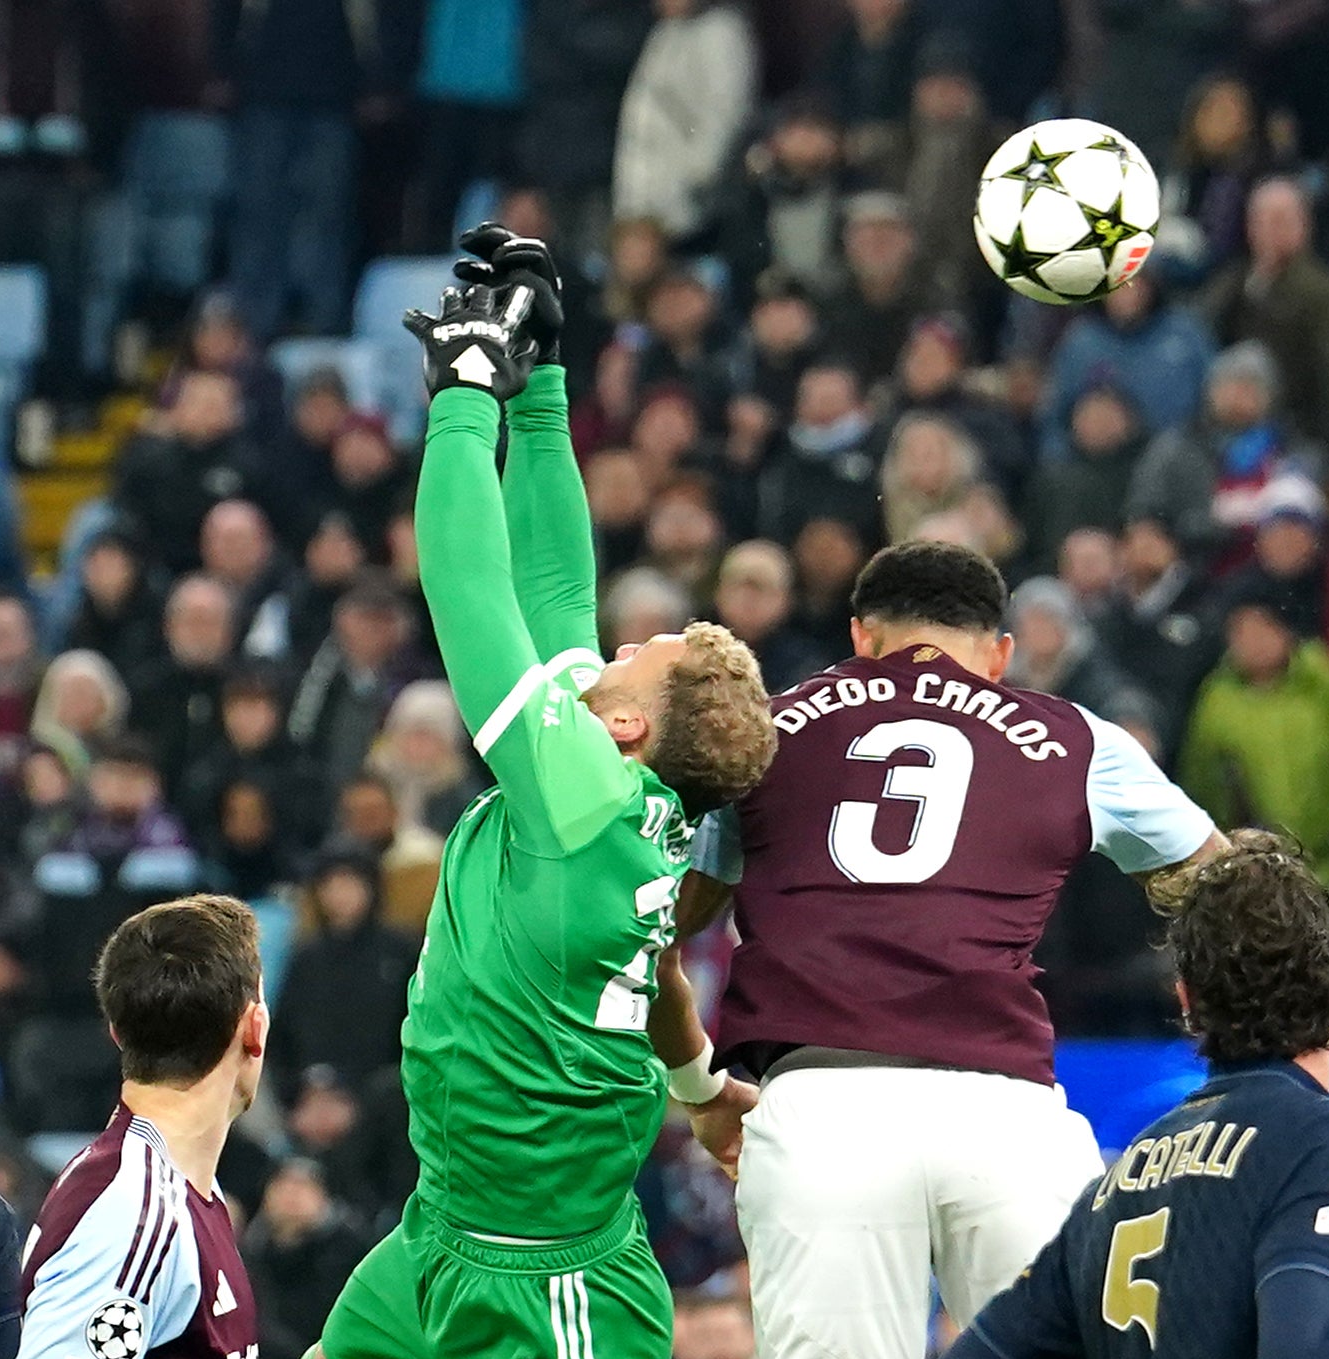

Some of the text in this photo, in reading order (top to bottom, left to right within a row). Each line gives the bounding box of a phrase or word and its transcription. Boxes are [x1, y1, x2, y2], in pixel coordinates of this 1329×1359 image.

[772, 672, 1068, 761] DIEGO CARLOS
[827, 718, 974, 884] 3
